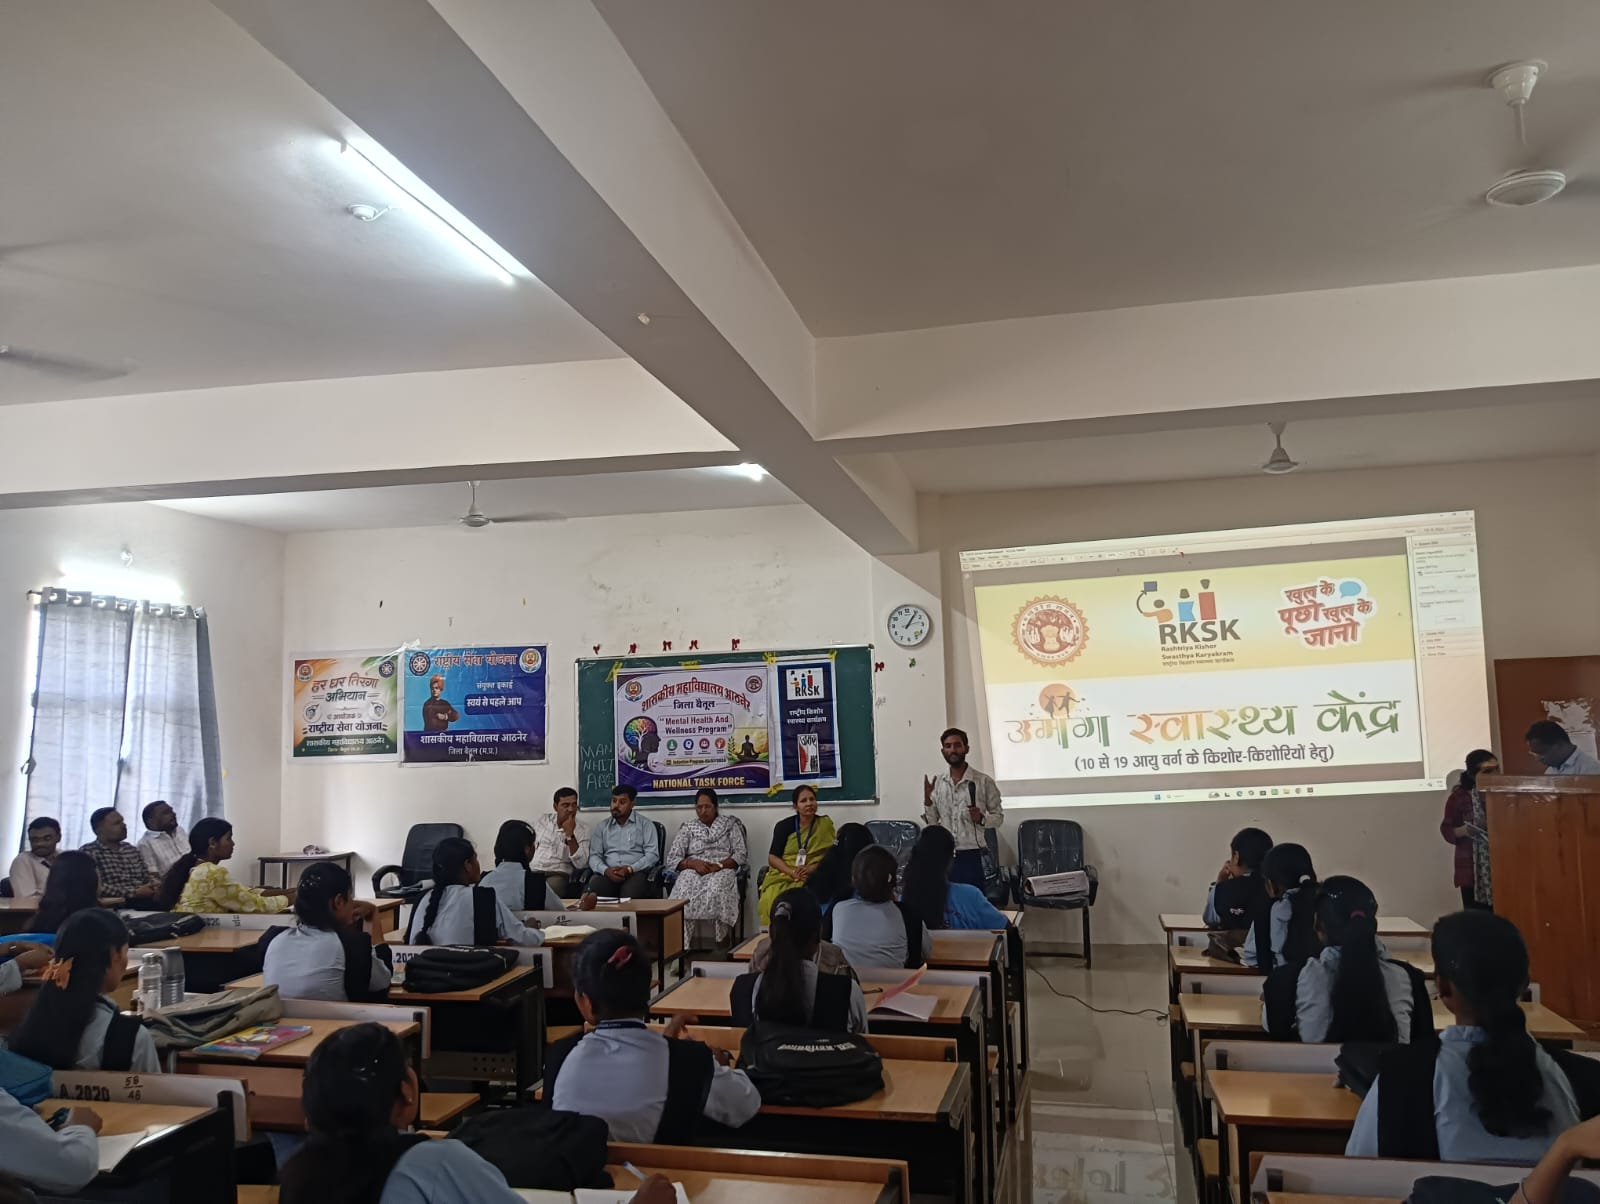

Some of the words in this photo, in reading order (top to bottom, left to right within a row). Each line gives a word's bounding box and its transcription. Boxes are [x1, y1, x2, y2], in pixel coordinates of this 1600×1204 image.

[1284, 585, 1318, 604] खुल
[1319, 580, 1336, 596] के
[1278, 600, 1325, 635] पूछो
[1321, 603, 1355, 623] खुल
[1356, 598, 1373, 614] के
[1159, 619, 1241, 645] RKSK
[1302, 618, 1360, 647] जानो
[1161, 644, 1194, 652] Rashtriya
[434, 652, 461, 669] राष्ट्रीय
[486, 651, 518, 666] योजना
[312, 679, 328, 693] हर
[329, 677, 347, 689] घर
[348, 672, 379, 689] तिरंगा
[325, 688, 368, 702] अभियान
[641, 684, 675, 712] शासकीय
[676, 677, 724, 696] महाविद्यालय
[795, 685, 820, 697] RKSK
[482, 696, 489, 706] से
[490, 695, 506, 707] पहले
[507, 697, 522, 706] आप
[673, 699, 694, 710] जिला
[690, 716, 714, 725] Health
[715, 715, 729, 723] And
[1127, 705, 1298, 744] स्वास्थ्य
[1313, 690, 1402, 740] केंद्र
[308, 722, 335, 734] राष्ट्रीय
[336, 721, 353, 732] सेवा
[355, 720, 383, 731] योजना
[665, 726, 697, 735] Wellness
[420, 732, 453, 744] शासकीय
[455, 732, 499, 744] महाविद्यालय
[501, 731, 528, 742] आठनेर
[448, 746, 463, 755] जिला
[1074, 755, 1095, 771] (10
[1098, 752, 1110, 769] से
[1114, 756, 1129, 768] 19
[1133, 754, 1160, 771] आयु
[1162, 748, 1182, 766] वर्ग
[1186, 751, 1200, 766] के
[1203, 743, 1305, 765] किशोर-किशोरियों
[1309, 742, 1335, 763] हेतु)
[653, 778, 692, 789] NATIONAL
[694, 777, 716, 788] TASK
[718, 776, 745, 786] FORCE
